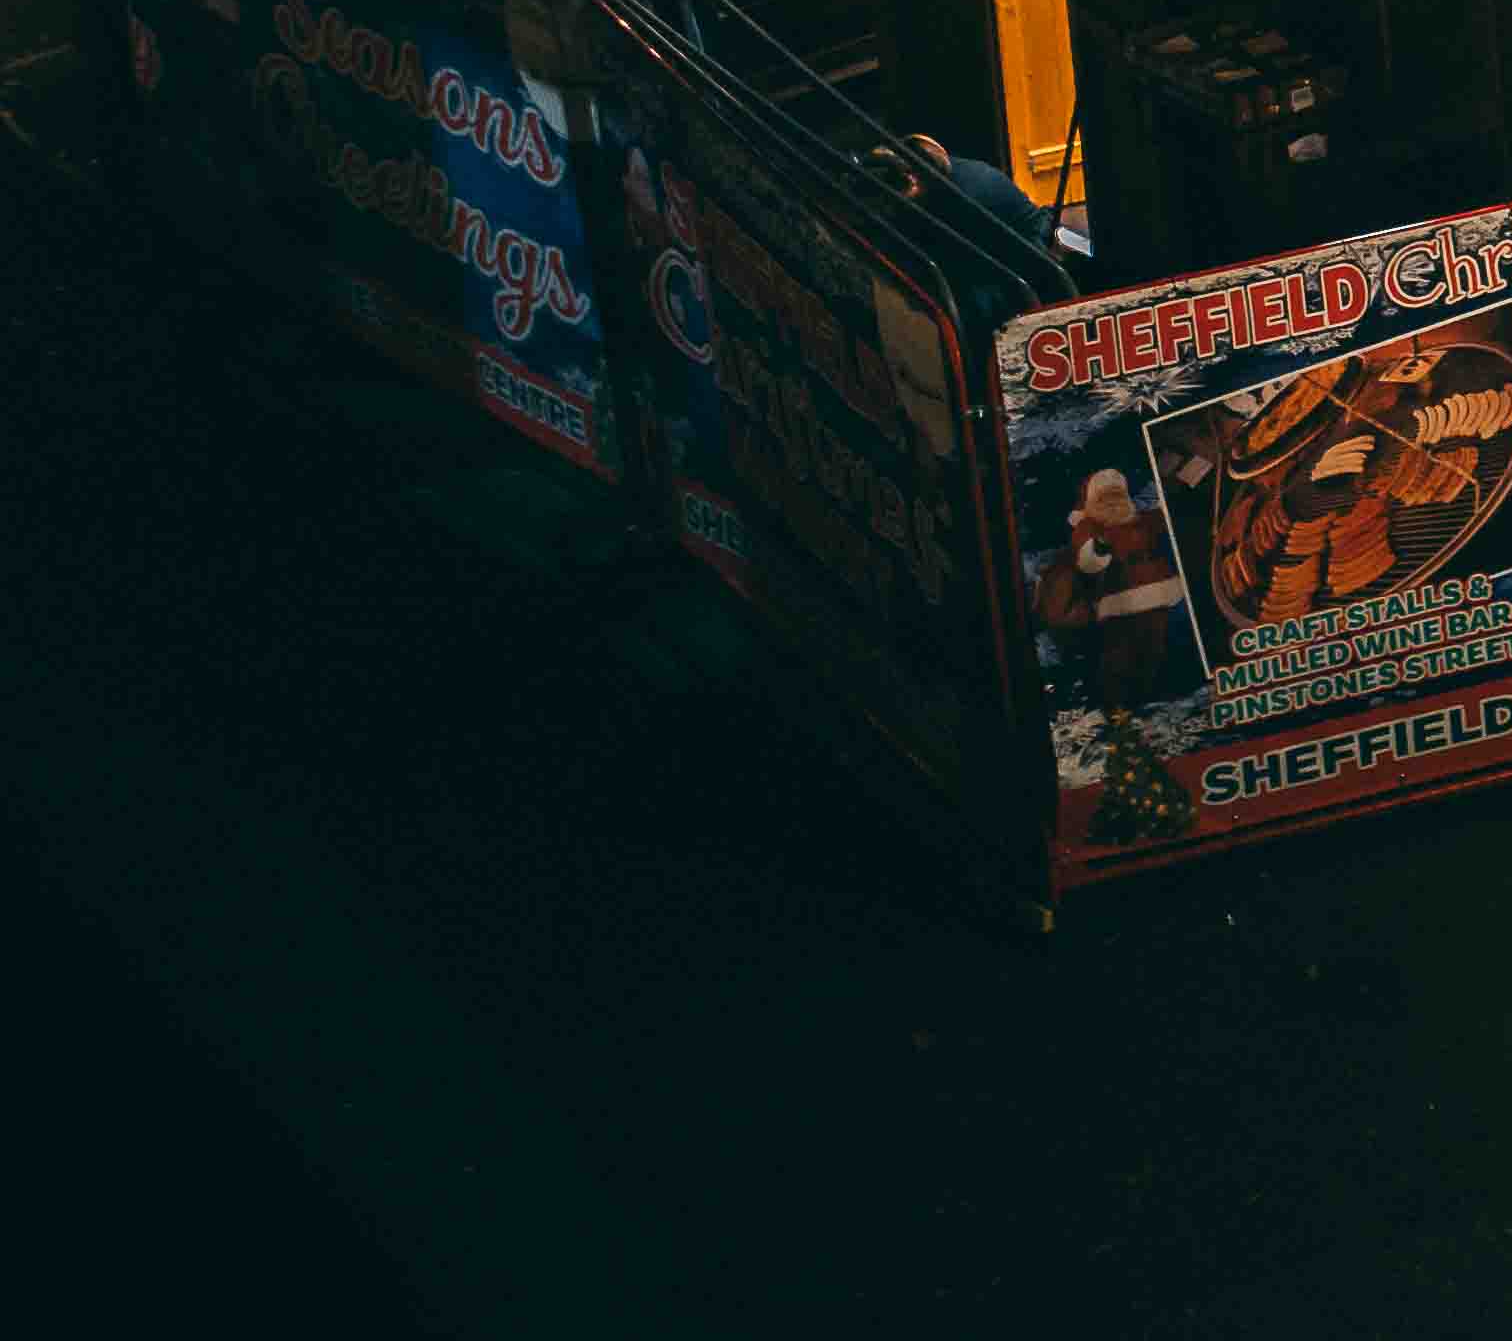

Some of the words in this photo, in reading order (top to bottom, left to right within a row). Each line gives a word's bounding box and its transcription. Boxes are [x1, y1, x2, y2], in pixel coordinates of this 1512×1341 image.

[1026, 261, 1370, 392] SHEFFIELD
[1231, 607, 1344, 656] CRAFT
[1344, 579, 1463, 630] STALLS
[1466, 573, 1493, 601] &
[1210, 660, 1399, 728] PINSTONES
[1214, 642, 1353, 696] MULLED
[1352, 617, 1443, 663] WINE
